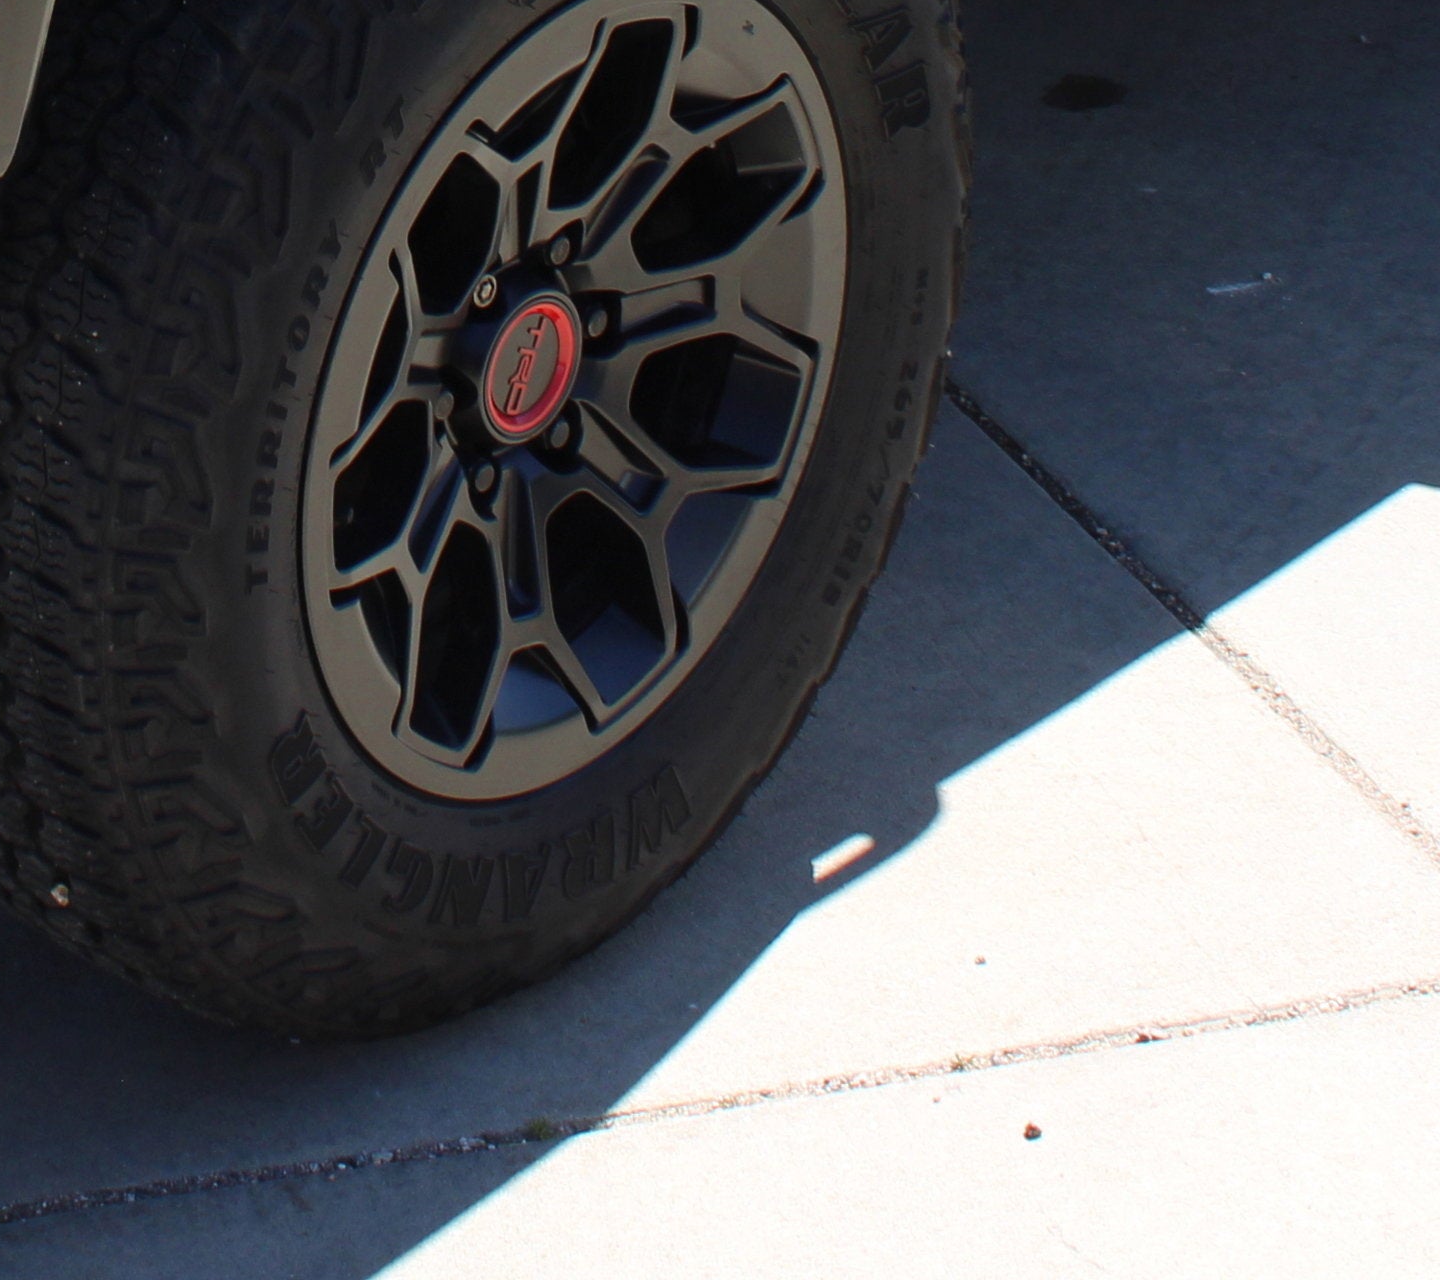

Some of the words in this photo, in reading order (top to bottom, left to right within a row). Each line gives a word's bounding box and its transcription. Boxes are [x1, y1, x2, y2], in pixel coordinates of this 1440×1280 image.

[245, 217, 344, 596] TERRITORY
[503, 315, 548, 416] TRD
[268, 708, 695, 927] WRANGLER
